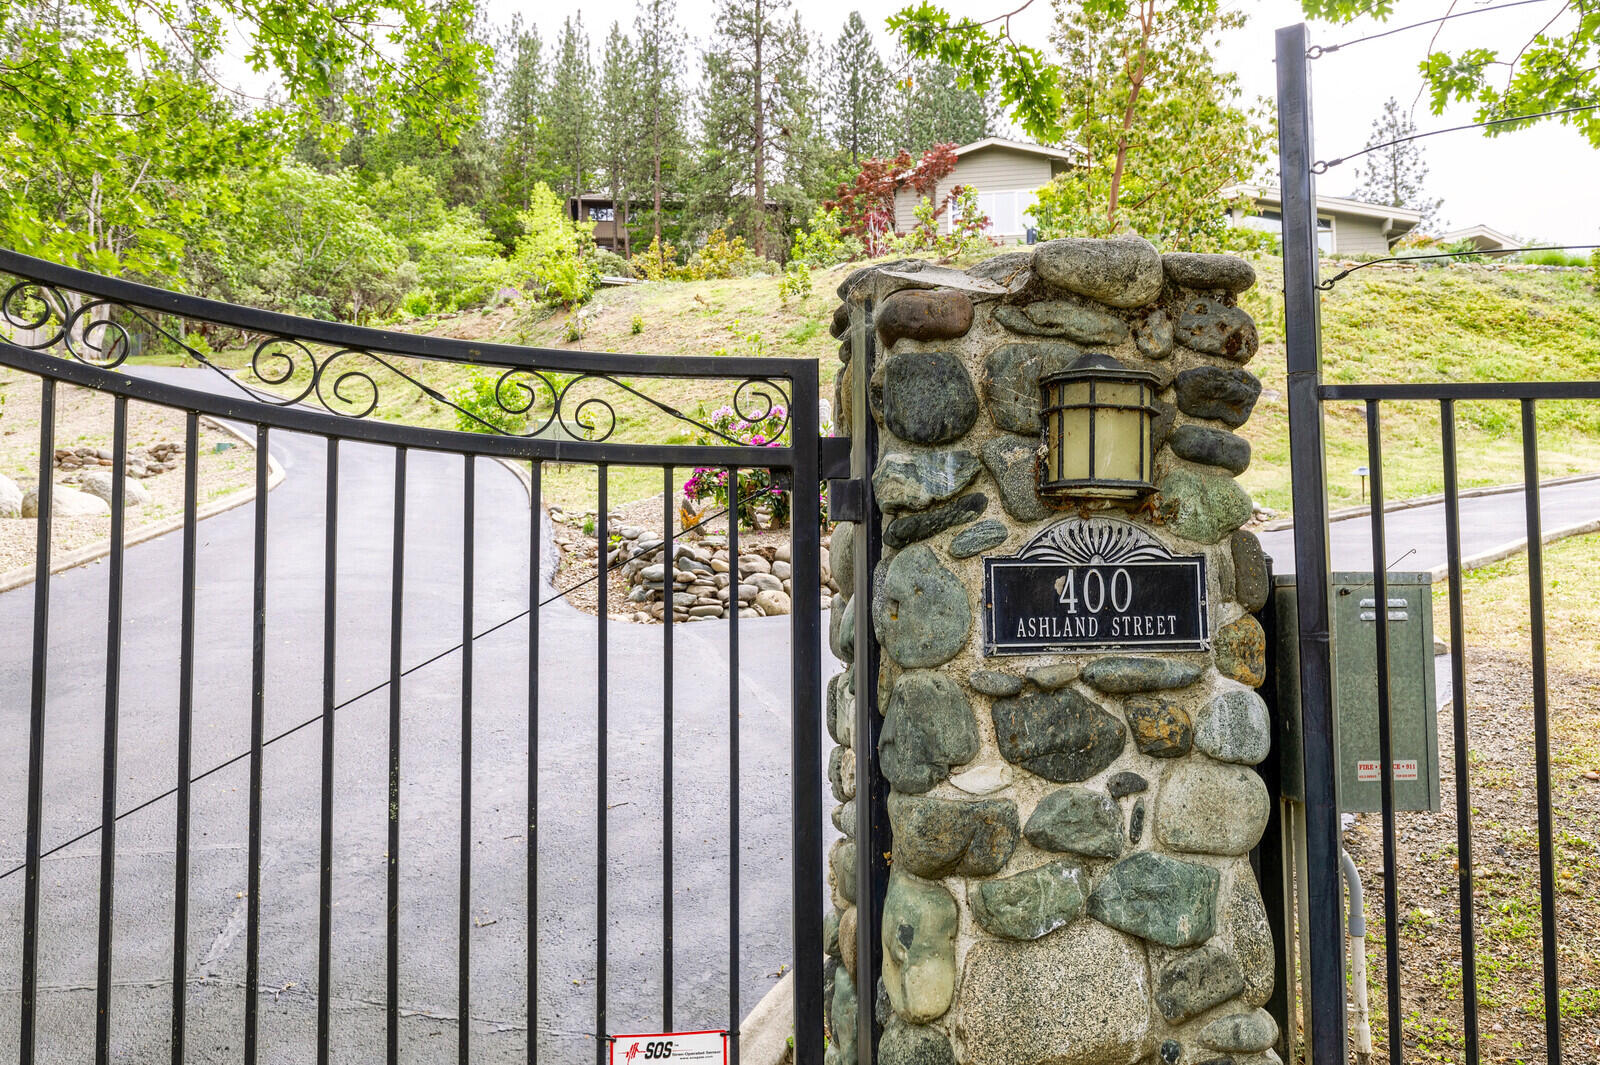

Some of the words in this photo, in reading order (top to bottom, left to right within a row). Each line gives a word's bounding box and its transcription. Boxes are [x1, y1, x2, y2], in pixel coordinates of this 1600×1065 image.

[1059, 568, 1133, 614] 400
[1017, 616, 1099, 638] ASHLAND
[1111, 615, 1177, 637] STREET
[644, 1041, 673, 1060] SOS
